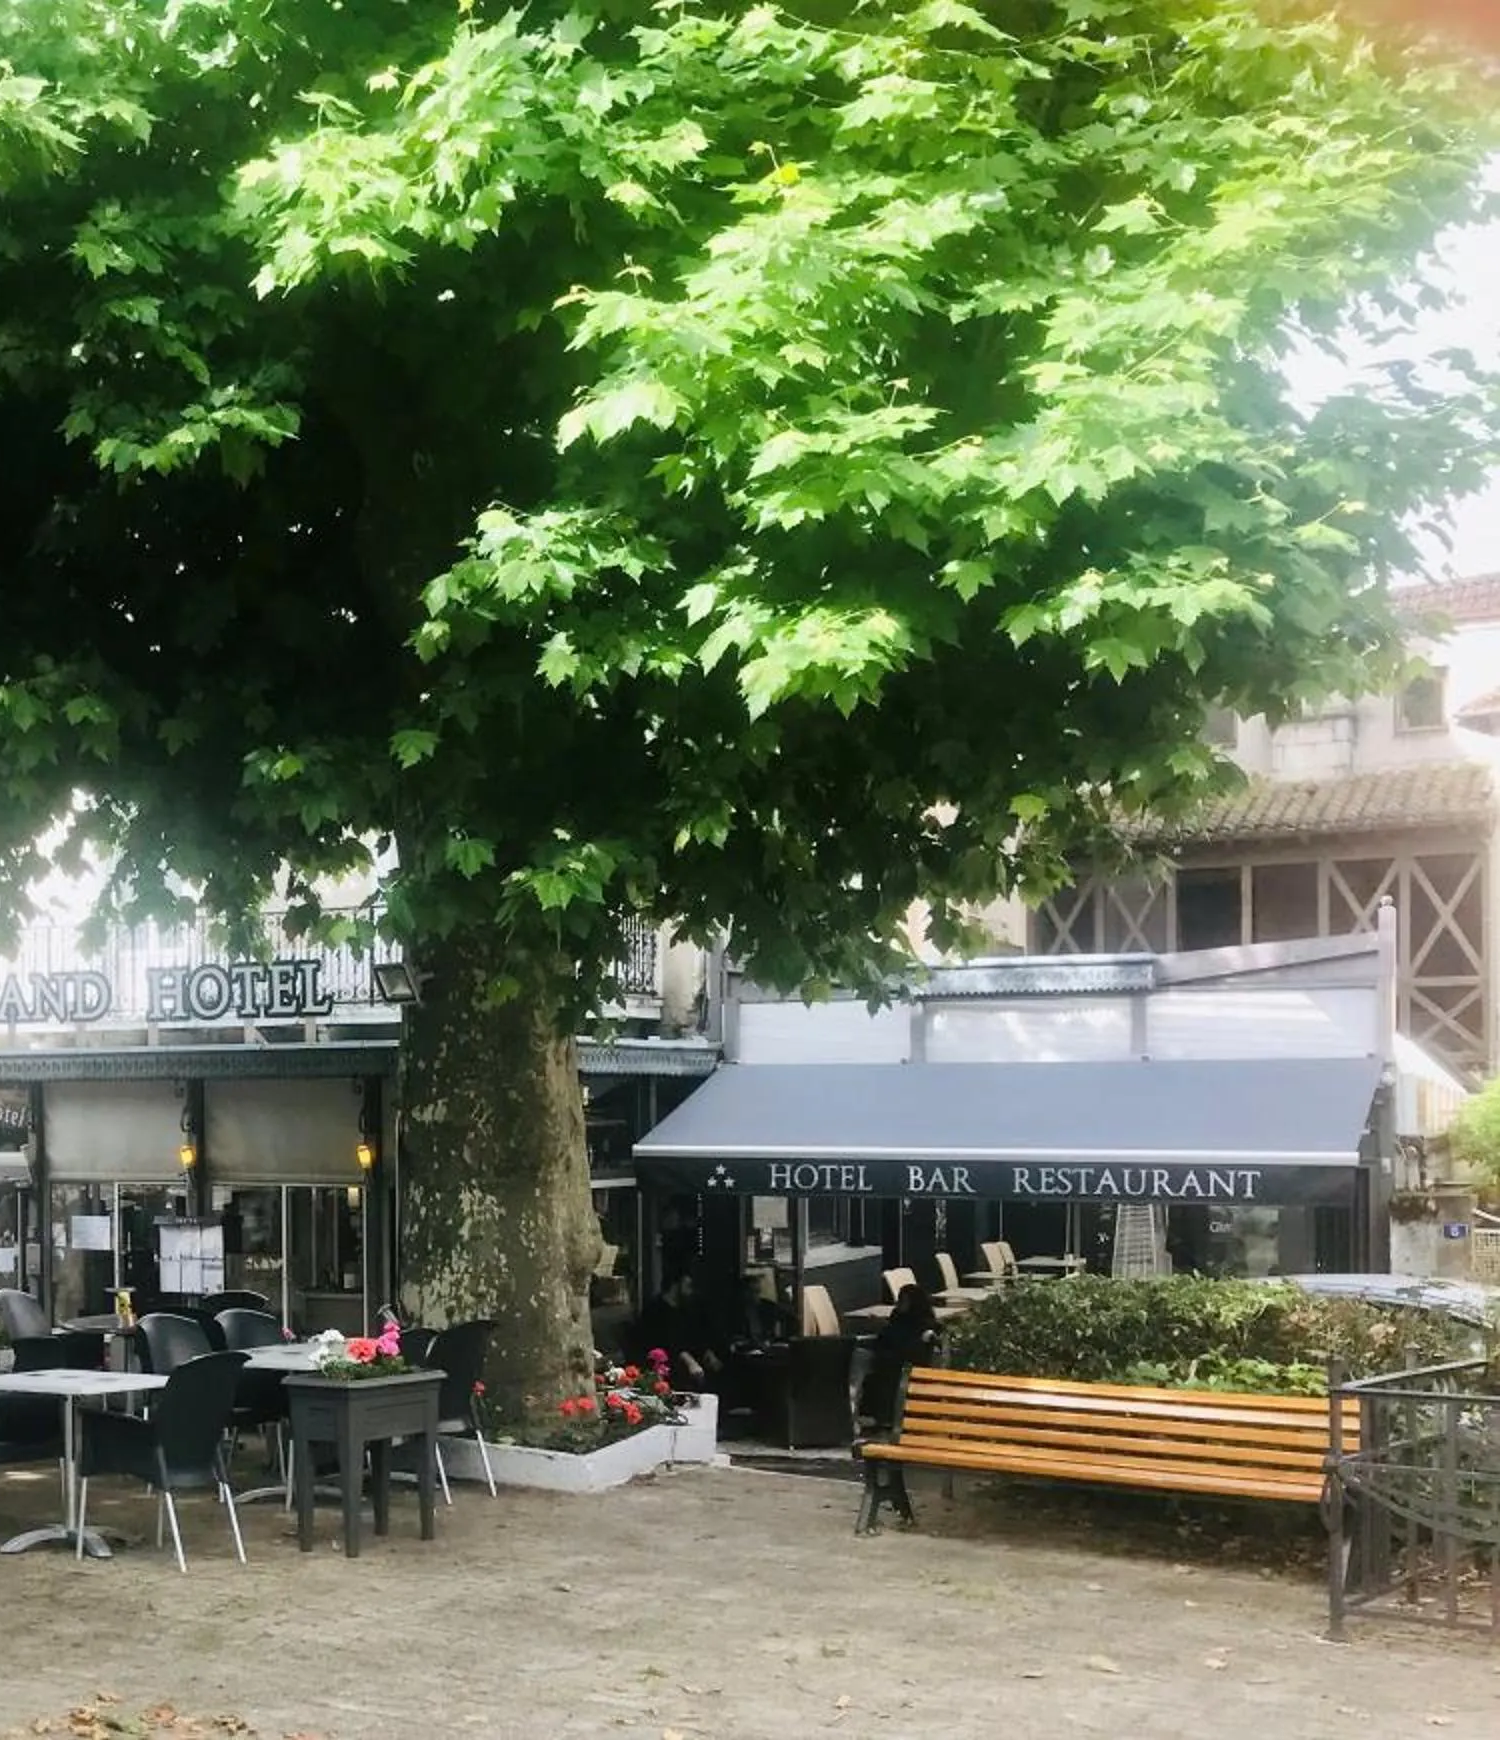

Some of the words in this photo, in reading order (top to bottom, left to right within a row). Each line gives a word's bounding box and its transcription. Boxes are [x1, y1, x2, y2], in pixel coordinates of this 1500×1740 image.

[147, 959, 333, 1022] HOTEL
[768, 1163, 873, 1192] HOTEL
[907, 1164, 977, 1194] BAR
[1011, 1167, 1262, 1198] RESTAURANT
